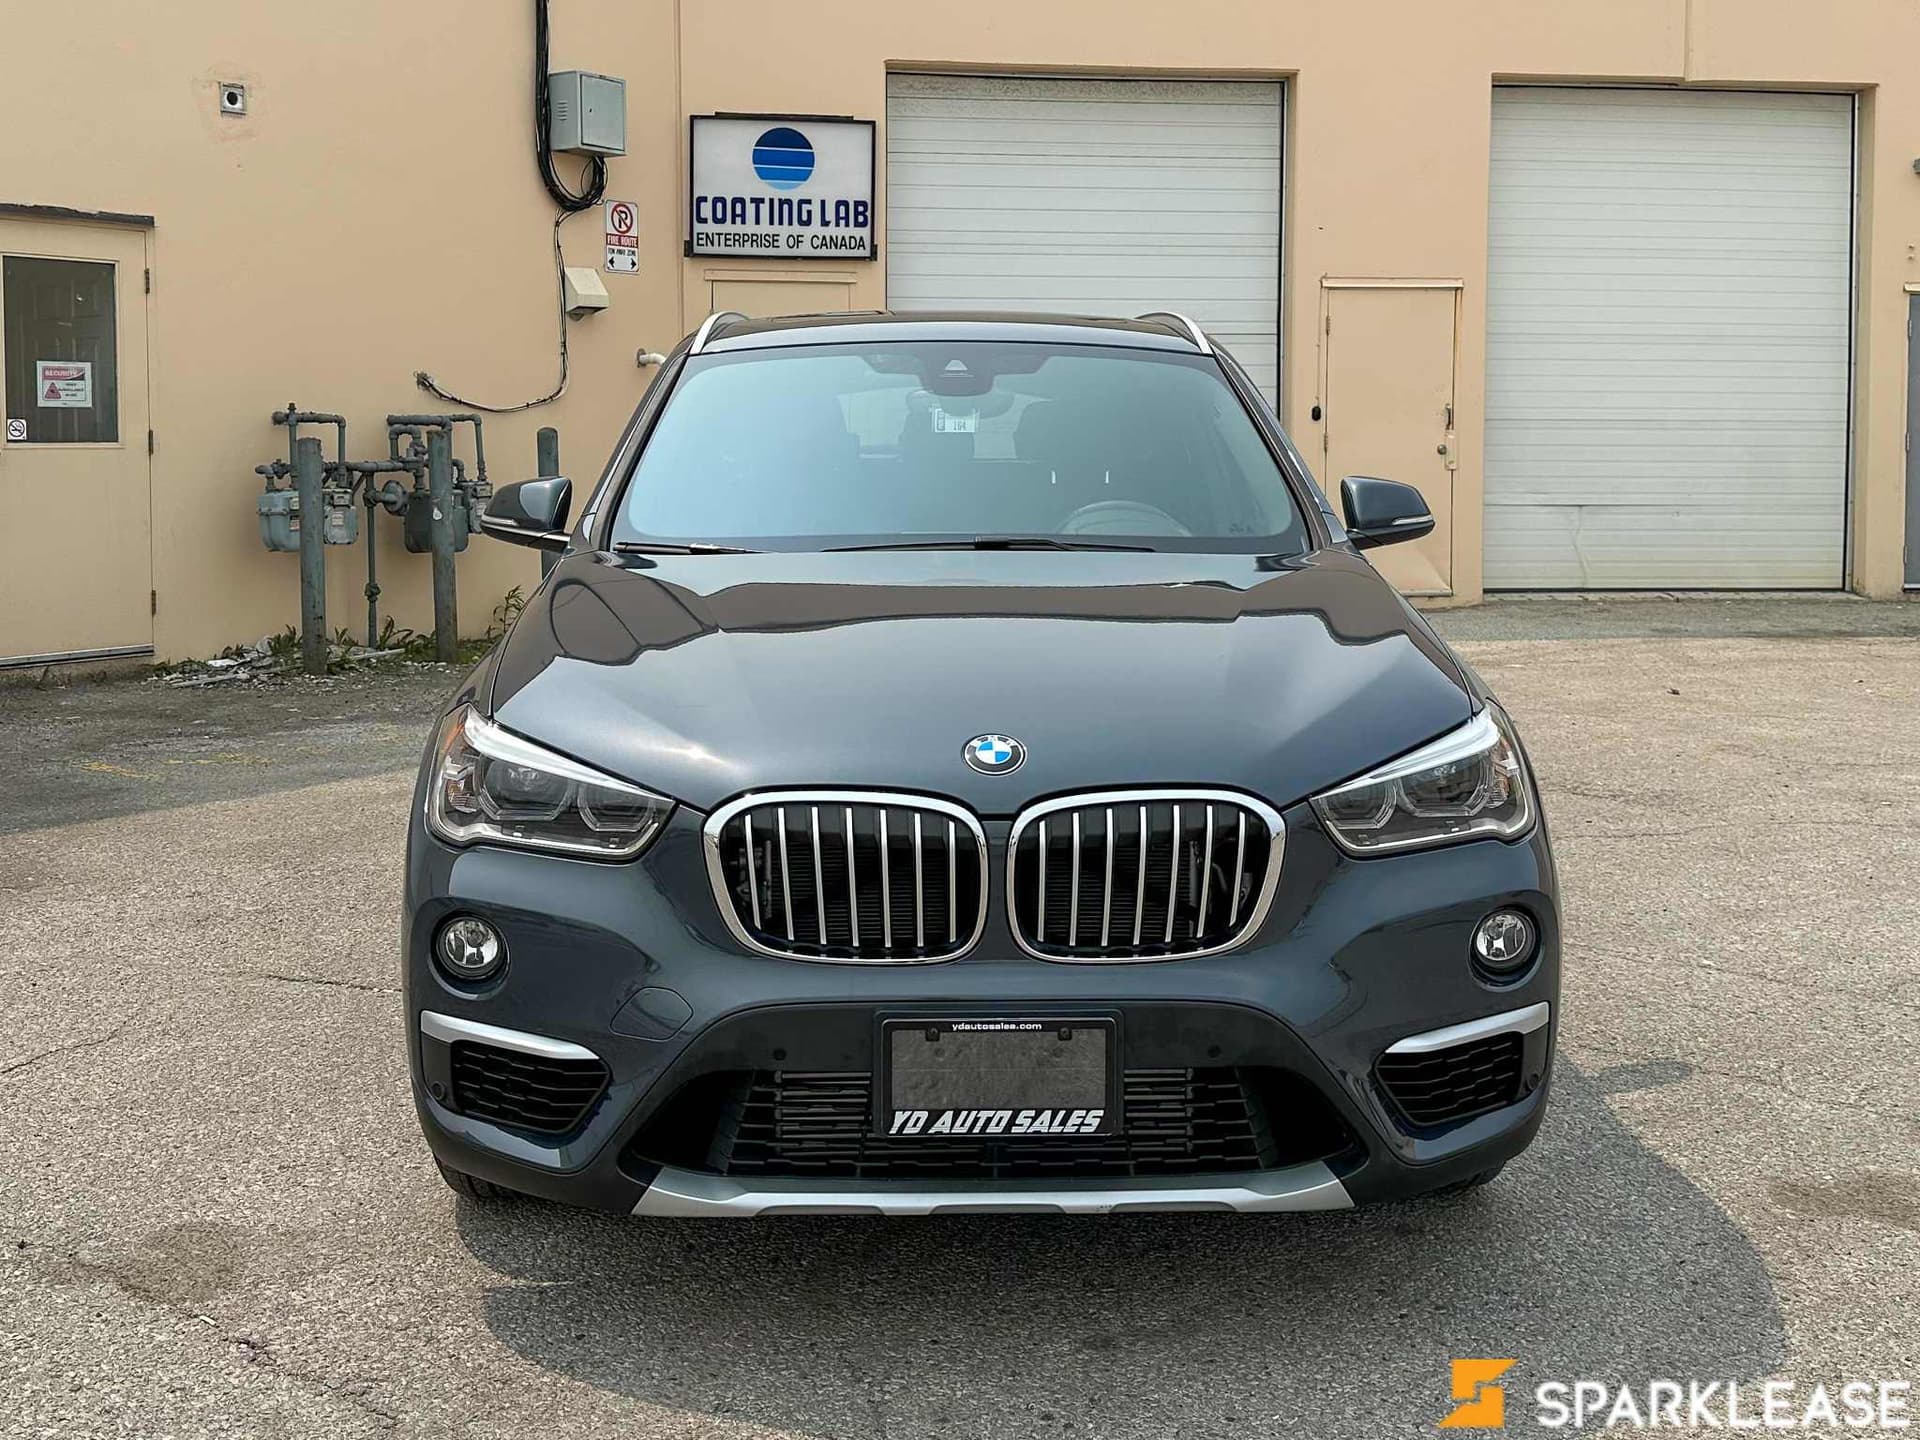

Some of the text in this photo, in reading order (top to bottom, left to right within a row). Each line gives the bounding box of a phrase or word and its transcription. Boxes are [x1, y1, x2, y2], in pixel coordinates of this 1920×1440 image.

[607, 235, 638, 248] FIRE ROUTE
[696, 232, 866, 250] ENTERPRISE OF CANADA
[952, 1021, 1042, 1032] ydautosales.com
[889, 1109, 1104, 1134] YD AUTO SALES
